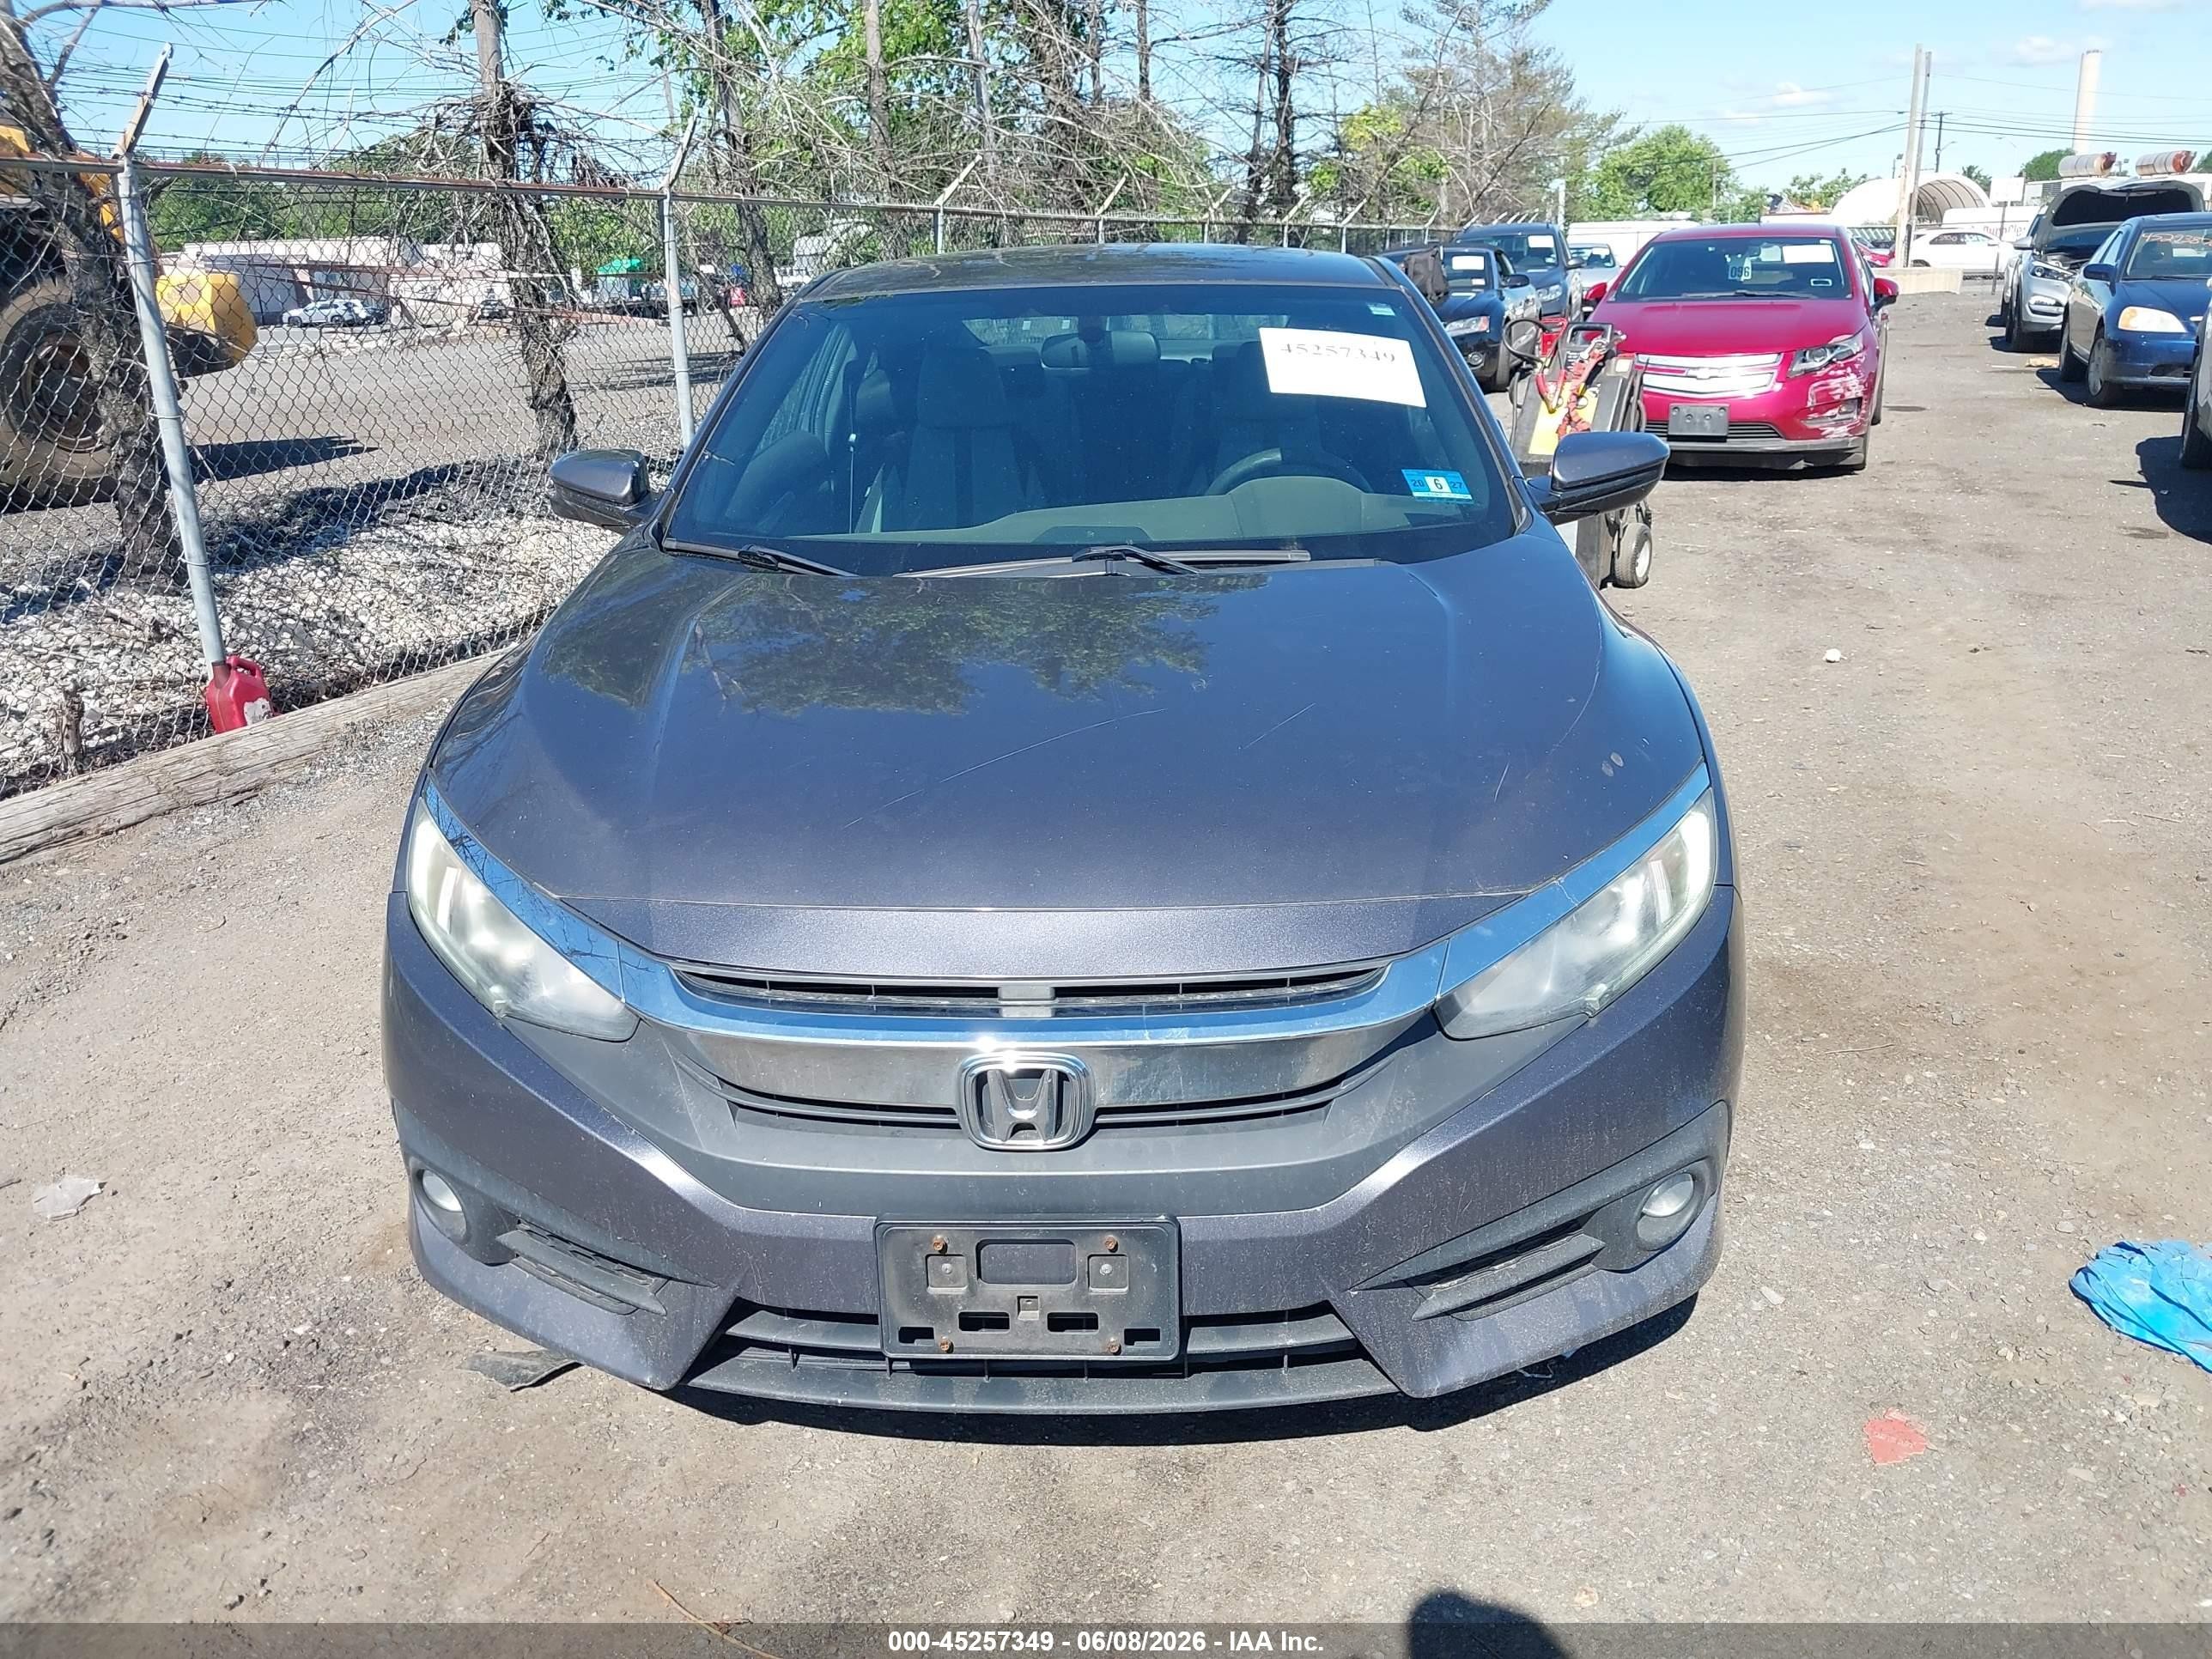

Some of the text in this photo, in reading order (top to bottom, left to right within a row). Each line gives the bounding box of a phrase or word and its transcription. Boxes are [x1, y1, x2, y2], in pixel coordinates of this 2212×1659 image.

[1280, 343, 1395, 362] 45257349
[1411, 478, 1462, 490] 20 6 27
